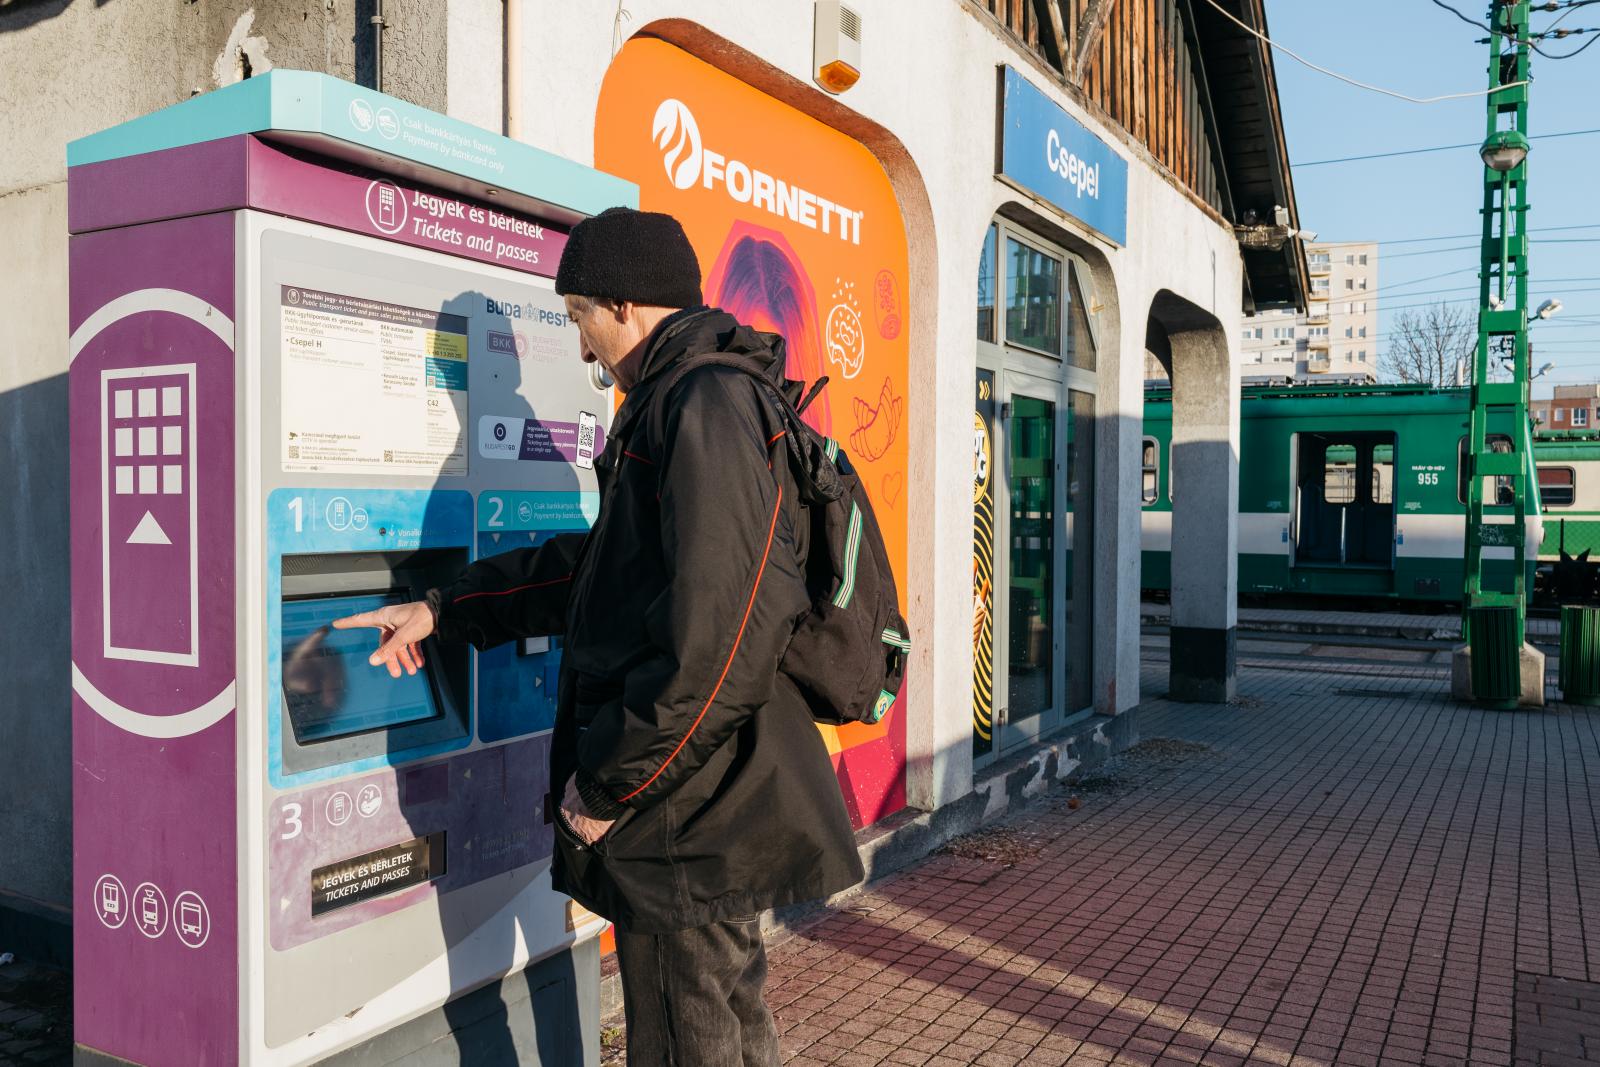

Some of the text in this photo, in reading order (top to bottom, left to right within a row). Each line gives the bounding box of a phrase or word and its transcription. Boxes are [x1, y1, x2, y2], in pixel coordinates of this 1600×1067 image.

[403, 131, 439, 151] Payment
[440, 144, 450, 157] by
[488, 160, 505, 173] only
[1047, 128, 1099, 199] Csepel
[412, 191, 544, 240] Jegyek és bérletek
[703, 148, 861, 245] FORNETTI
[413, 217, 539, 264] Tickets and passes
[290, 337, 322, 348] Csepel H
[492, 336, 511, 349] BKK
[427, 399, 438, 407] C42
[1418, 473, 1438, 485] 955
[287, 497, 303, 533] 1
[488, 497, 504, 527] 2
[281, 802, 302, 840] 3
[321, 851, 413, 889] JEGYEK ÉS BÉRLETEK
[325, 865, 411, 903] TICKETS AND PASSES
